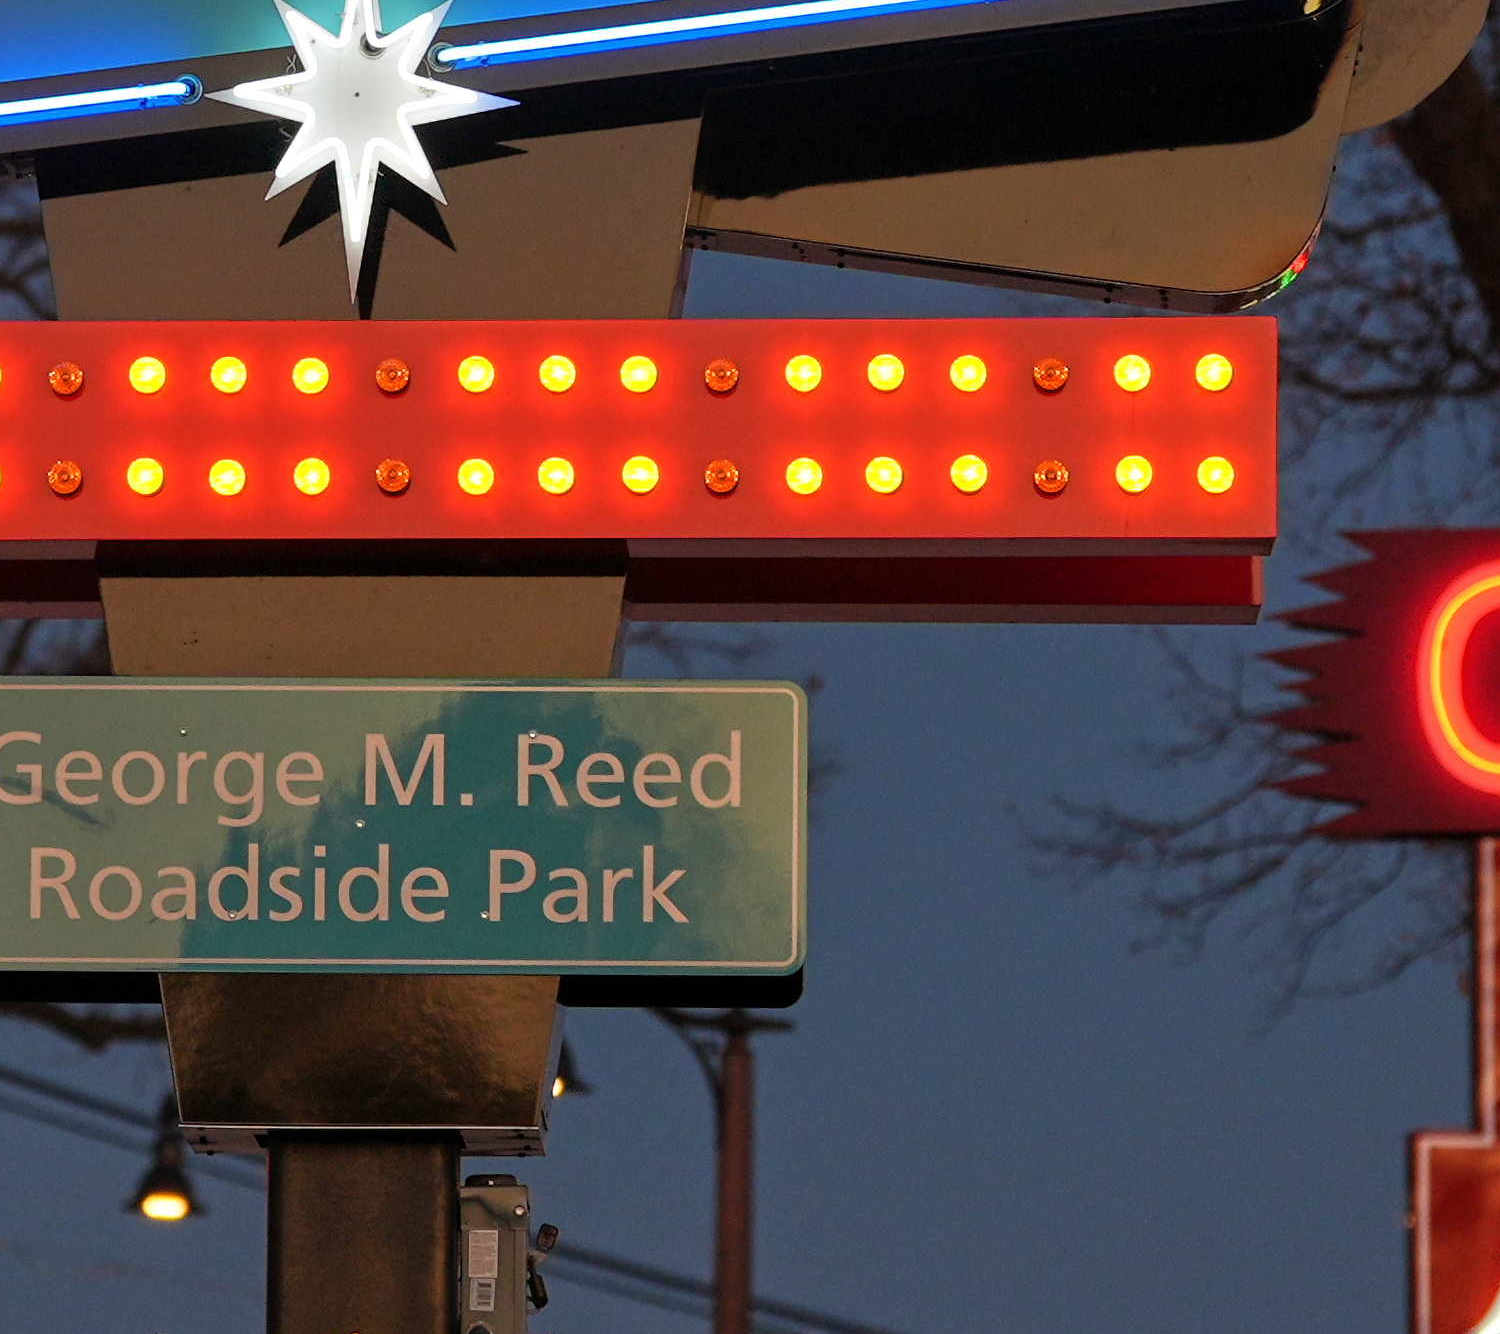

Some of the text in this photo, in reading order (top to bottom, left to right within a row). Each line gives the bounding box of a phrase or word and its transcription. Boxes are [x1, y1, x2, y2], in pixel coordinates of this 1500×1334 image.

[363, 732, 474, 807] M.
[516, 729, 742, 808] Reed
[27, 842, 690, 924] Roadside Park
